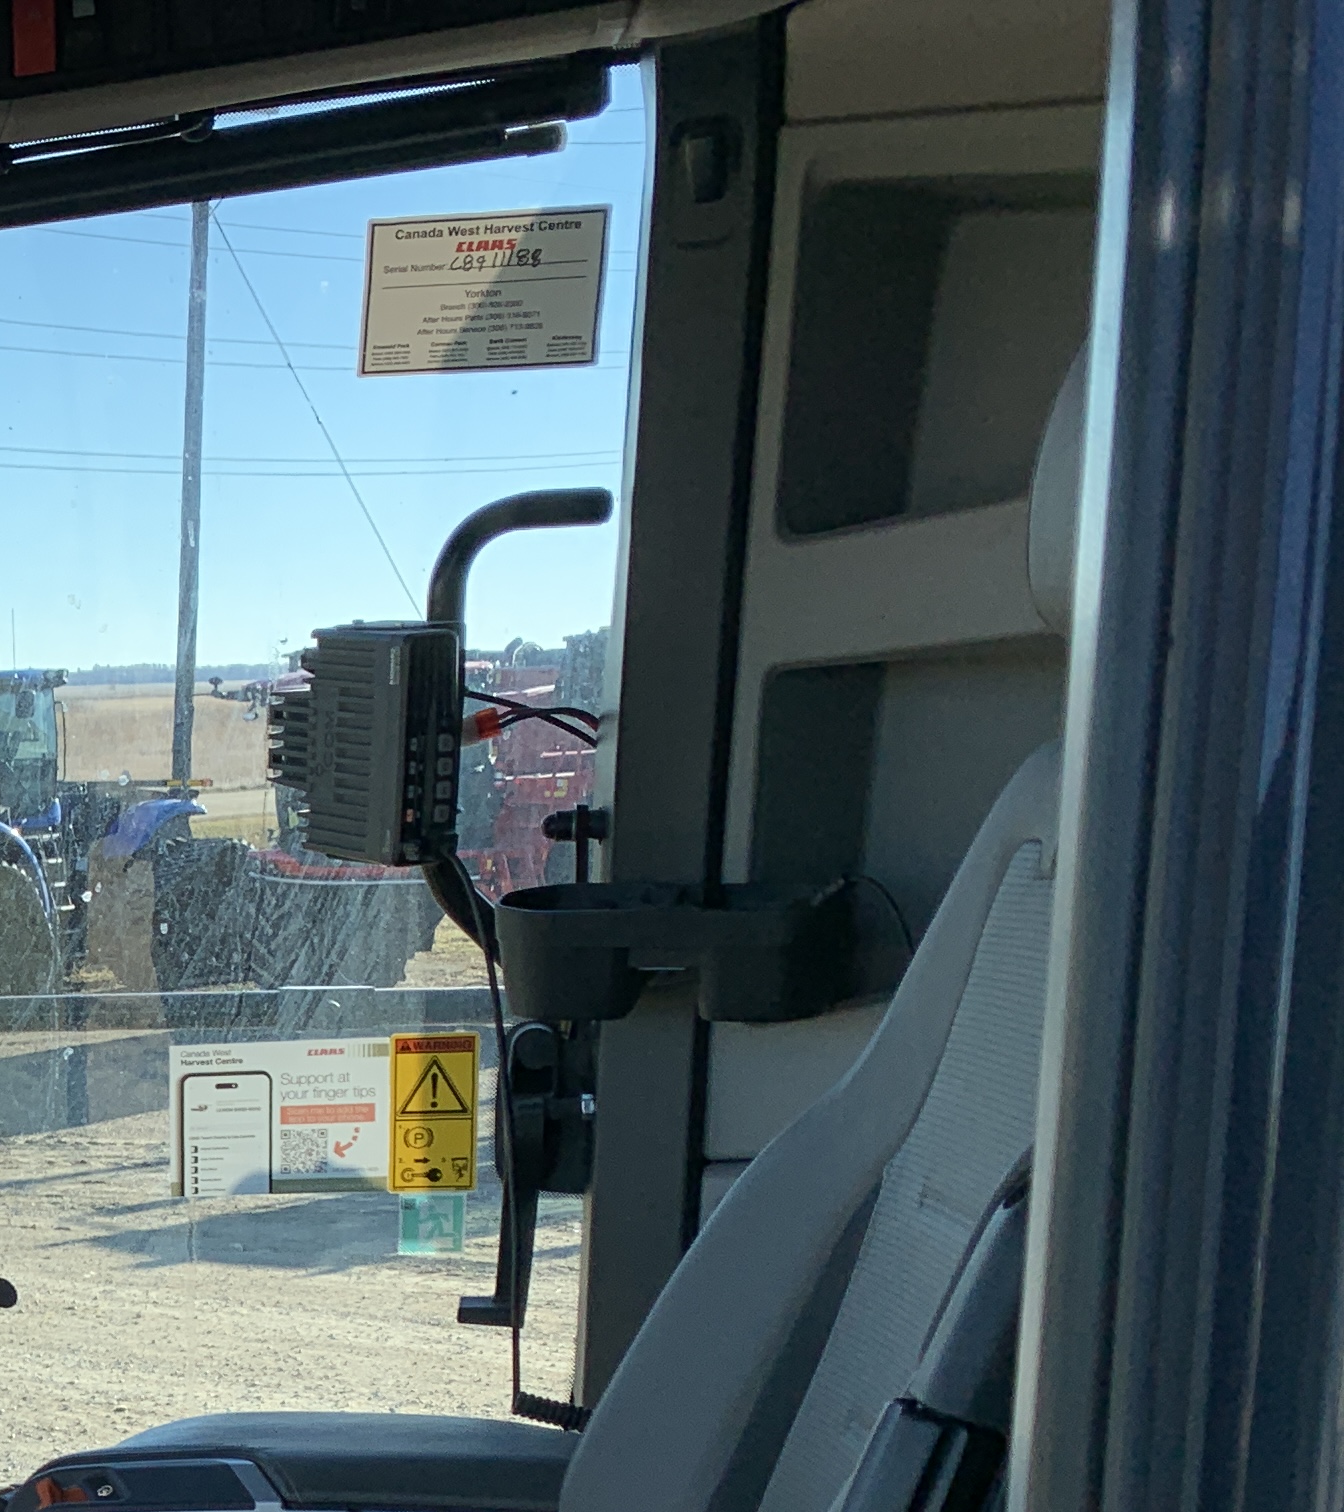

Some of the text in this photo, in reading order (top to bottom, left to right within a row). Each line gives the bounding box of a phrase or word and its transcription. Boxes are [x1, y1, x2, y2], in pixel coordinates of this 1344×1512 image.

[395, 219, 582, 240] Canada West Harvest Centre
[456, 238, 518, 253] CLAAS
[383, 265, 409, 274] Serial
[413, 1039, 472, 1050] WARNING
[180, 1049, 232, 1058] Canada West
[306, 1048, 345, 1057] CLAAS
[180, 1057, 244, 1067] Harvest Centre
[280, 1072, 351, 1087] Support at
[280, 1085, 377, 1102] your finger tips
